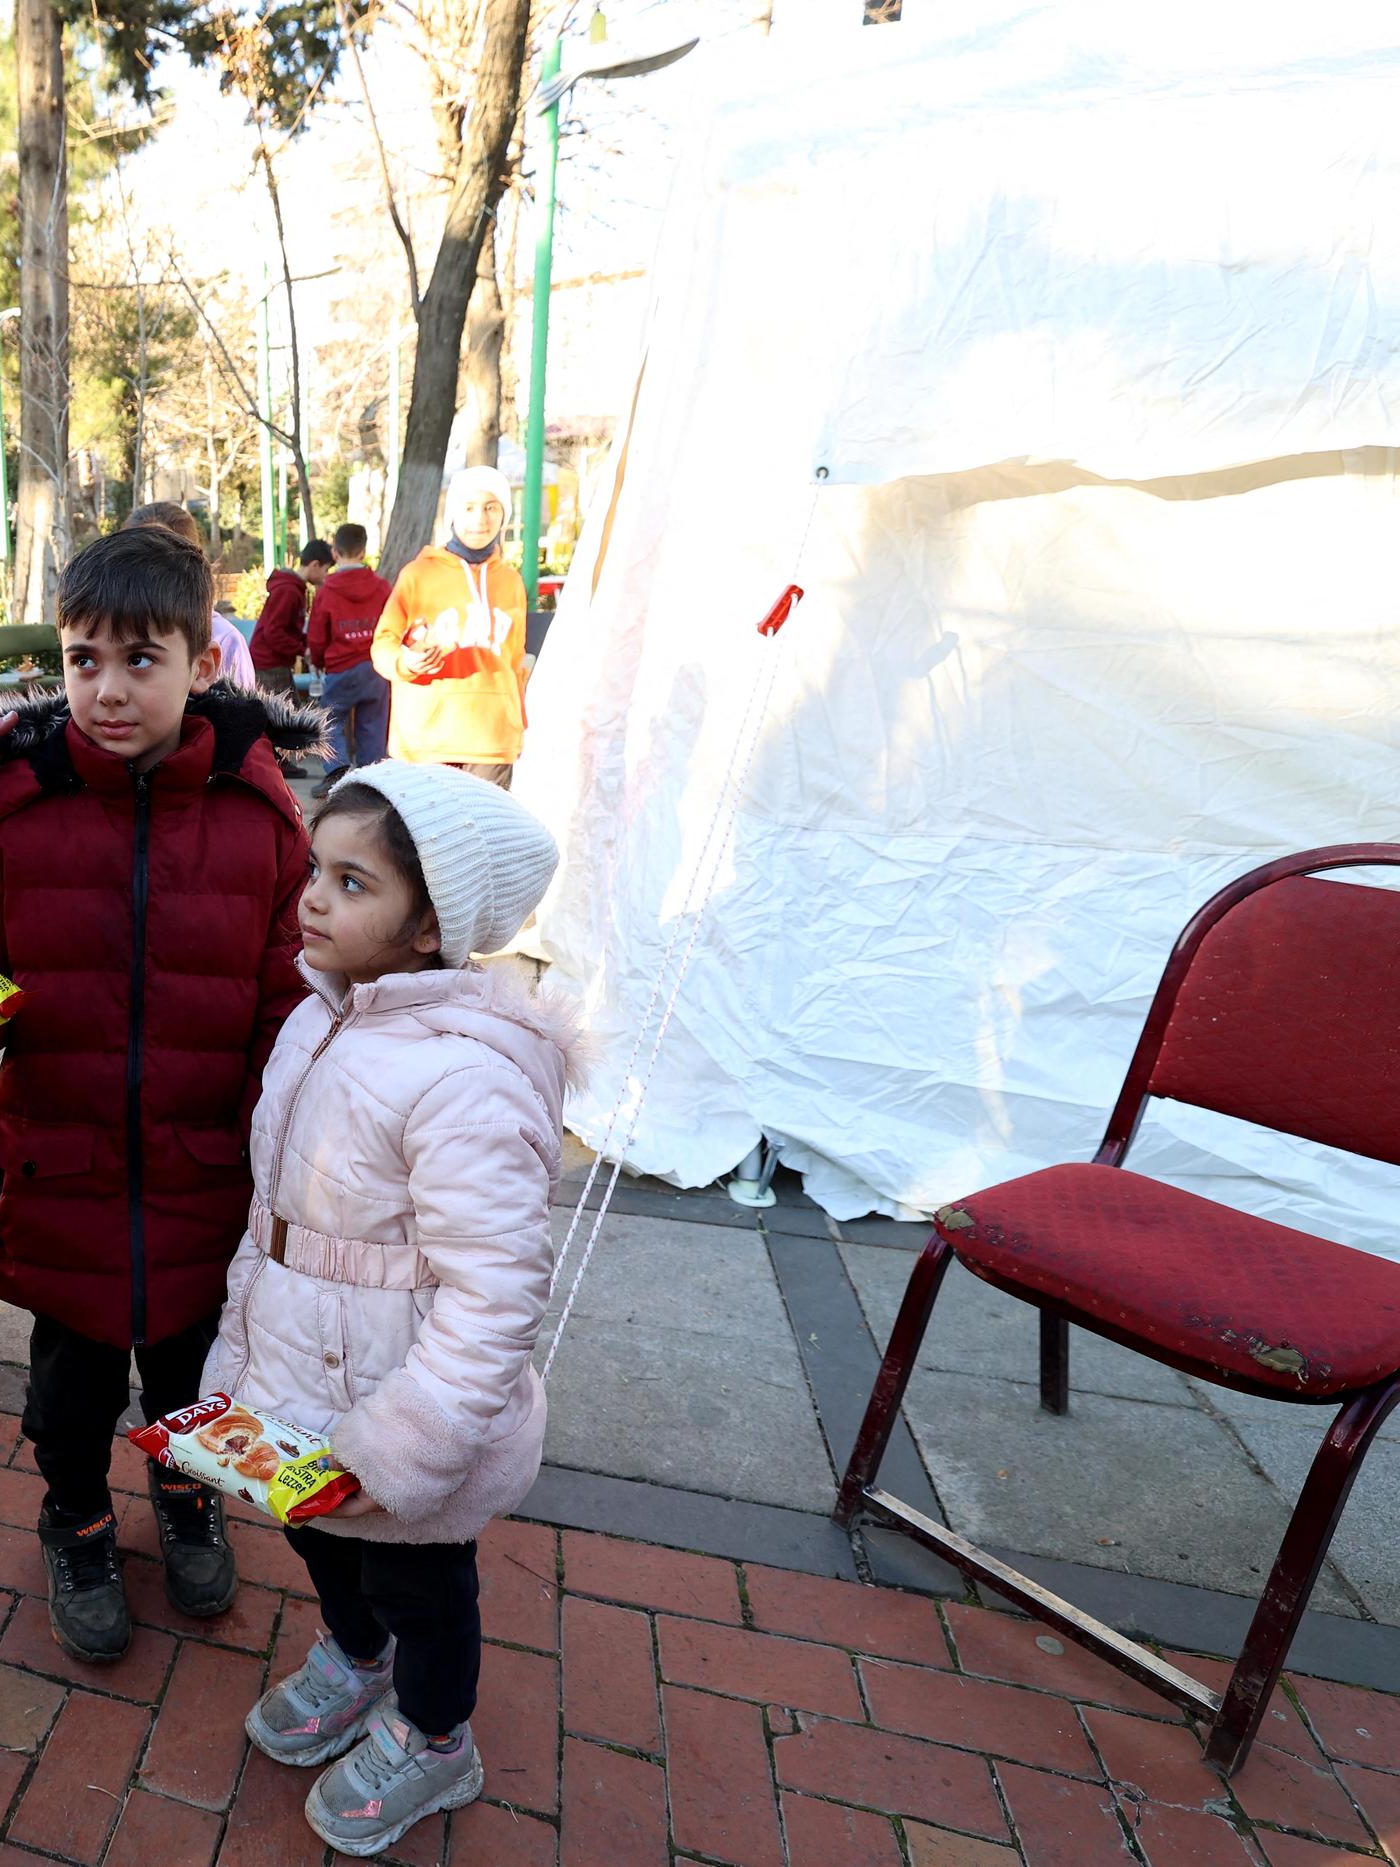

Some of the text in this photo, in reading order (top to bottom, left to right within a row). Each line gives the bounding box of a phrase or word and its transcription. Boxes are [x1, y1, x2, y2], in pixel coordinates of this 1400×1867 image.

[159, 1483, 202, 1491] WISCO
[181, 1461, 226, 1488] Croissant
[278, 1469, 307, 1495] Lezzet
[75, 1513, 113, 1537] WISCO
